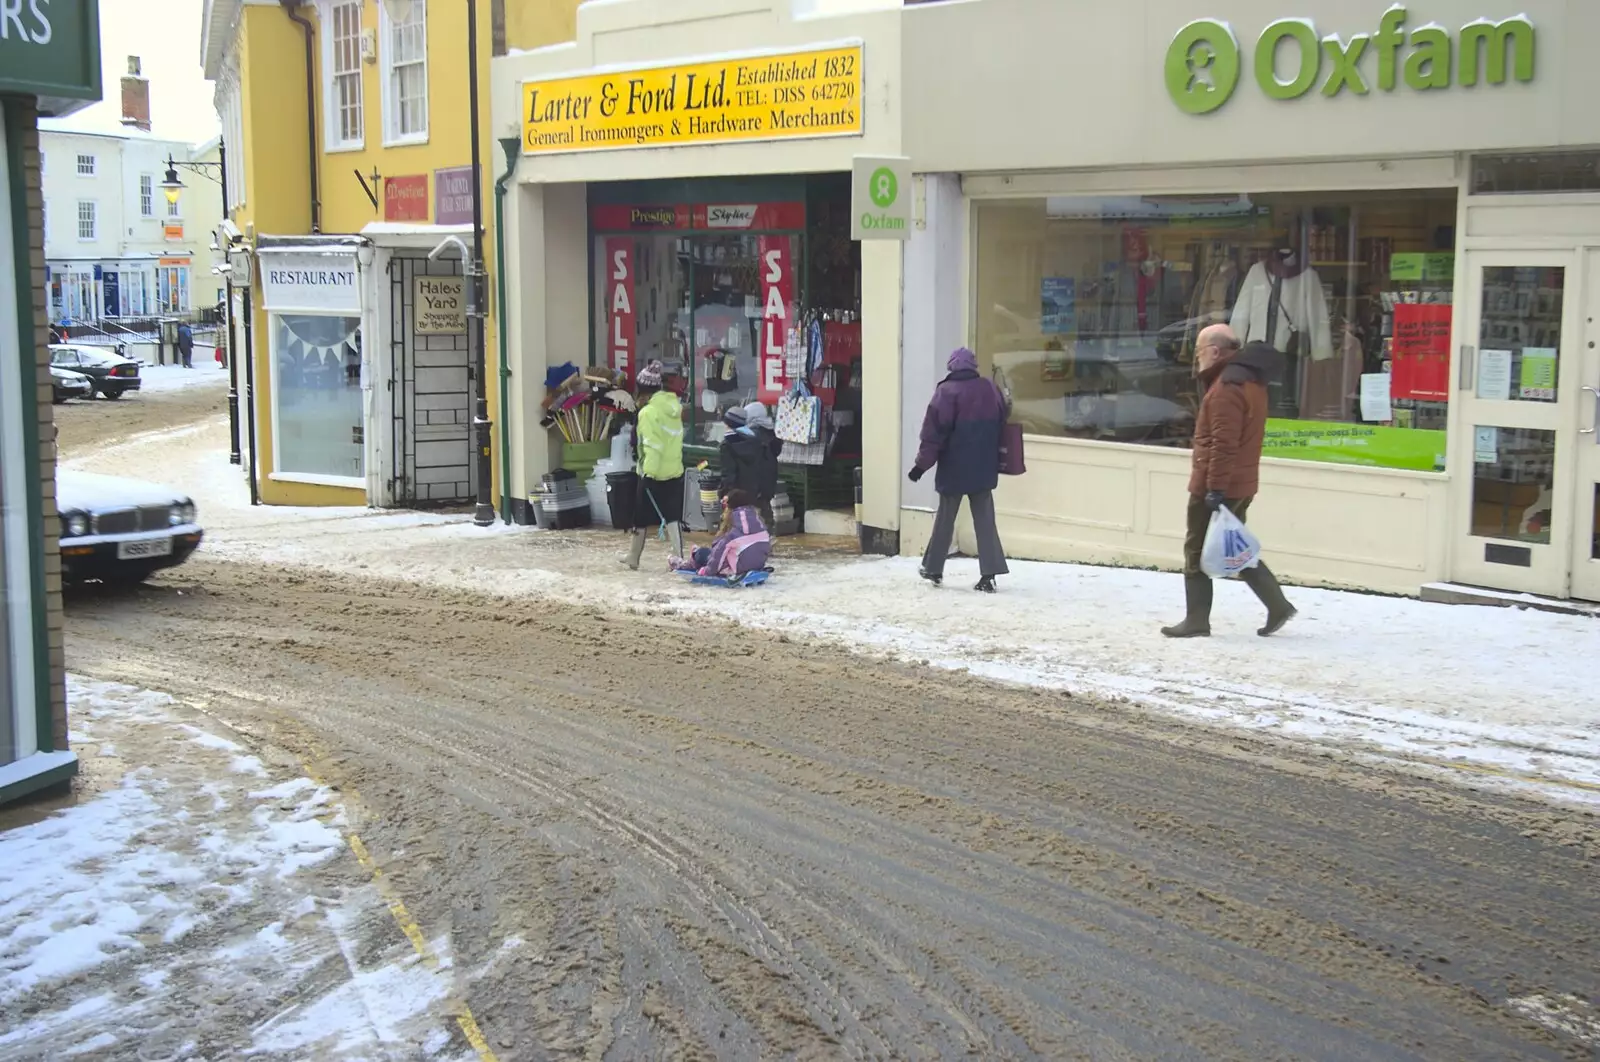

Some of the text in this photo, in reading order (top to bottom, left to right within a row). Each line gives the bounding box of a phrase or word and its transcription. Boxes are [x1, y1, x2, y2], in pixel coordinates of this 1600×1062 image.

[1254, 5, 1536, 99] Oxfam
[736, 55, 855, 88] Established 1832
[528, 69, 731, 124] Larter & Ford Ltd.
[736, 81, 855, 108] TEL: DISS 642720
[528, 106, 855, 147] General Ironmongers & Hardware Merchants
[631, 209, 676, 224] Prestige
[861, 212, 905, 231] Oxfam
[270, 271, 355, 286] RESTAURANT
[425, 296, 458, 310] Yard
[765, 250, 786, 391] SALE
